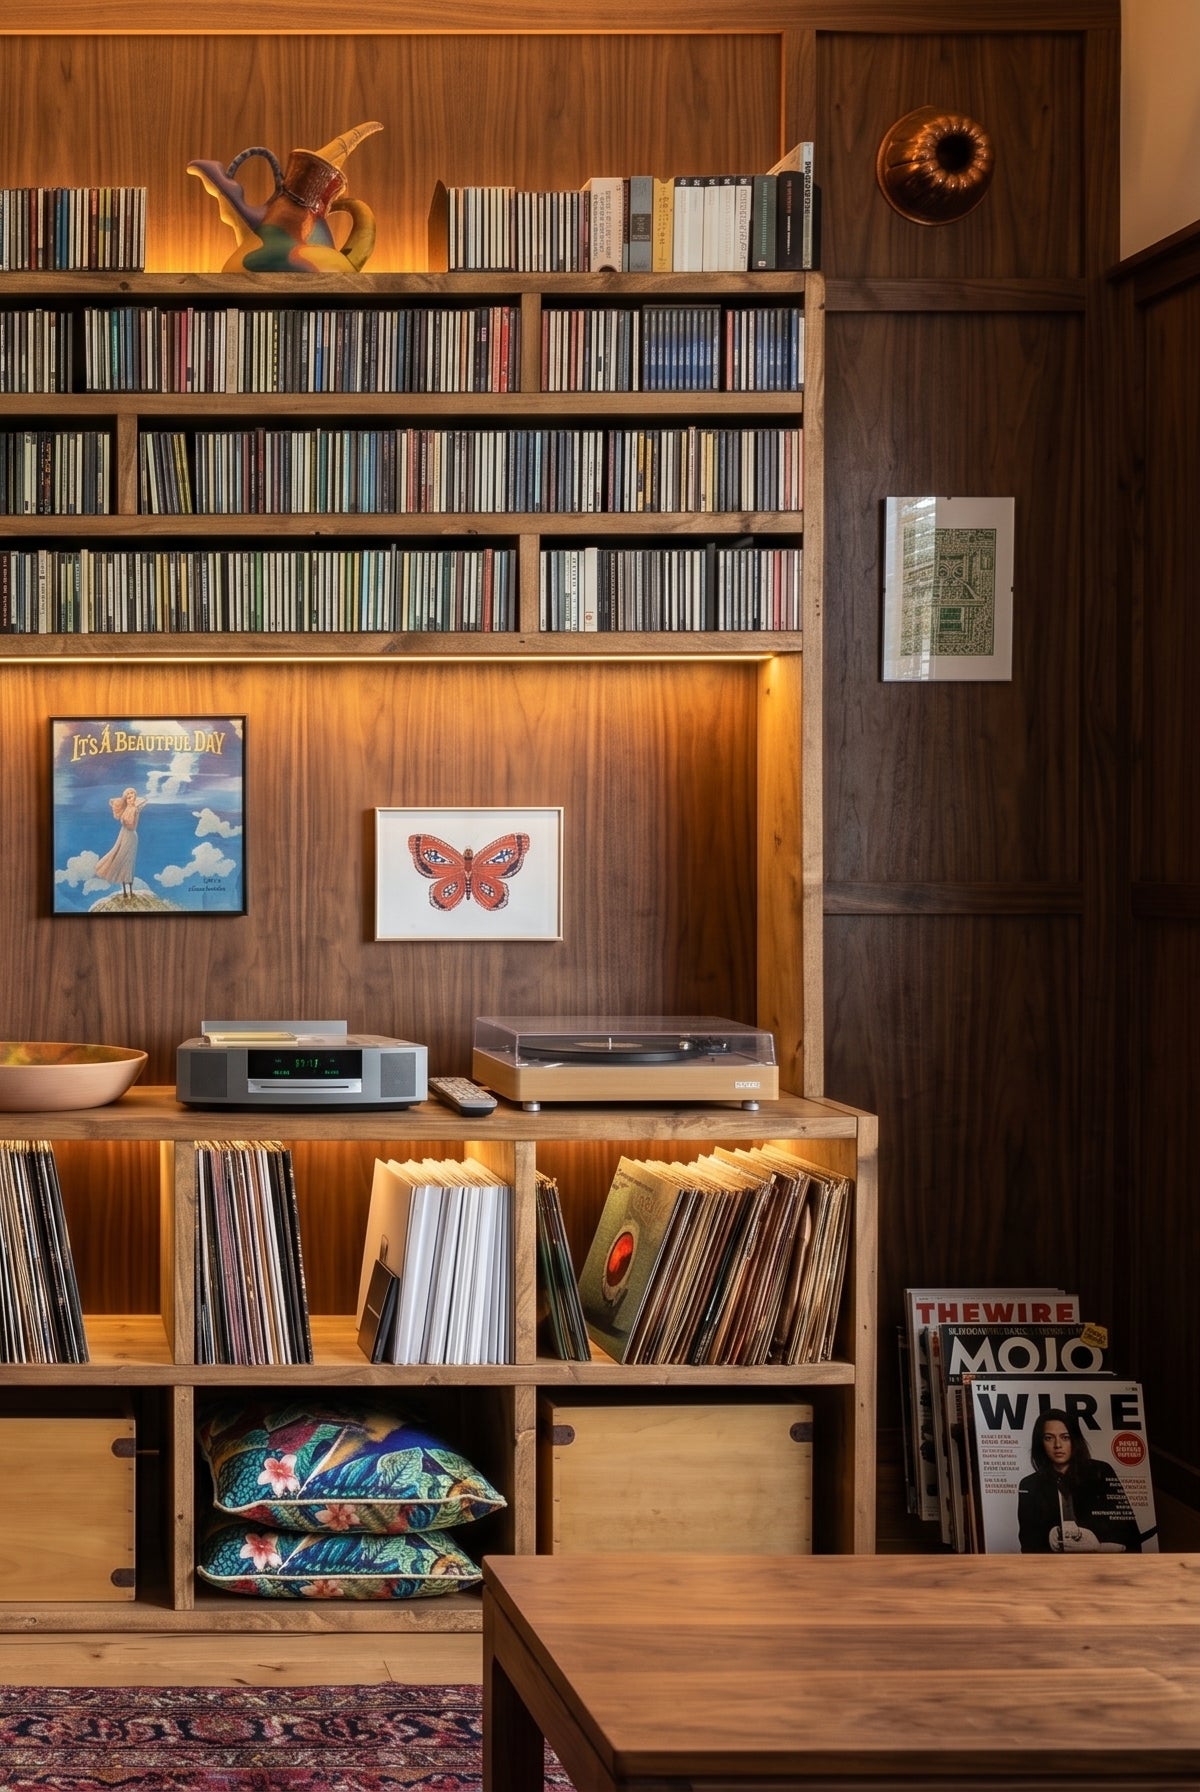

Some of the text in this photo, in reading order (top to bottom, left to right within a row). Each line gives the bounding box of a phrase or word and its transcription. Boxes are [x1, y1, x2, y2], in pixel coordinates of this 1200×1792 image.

[99, 725, 113, 754] A
[194, 730, 226, 755] DAY
[949, 1336, 1103, 1374] MOJO
[976, 1384, 997, 1392] THE
